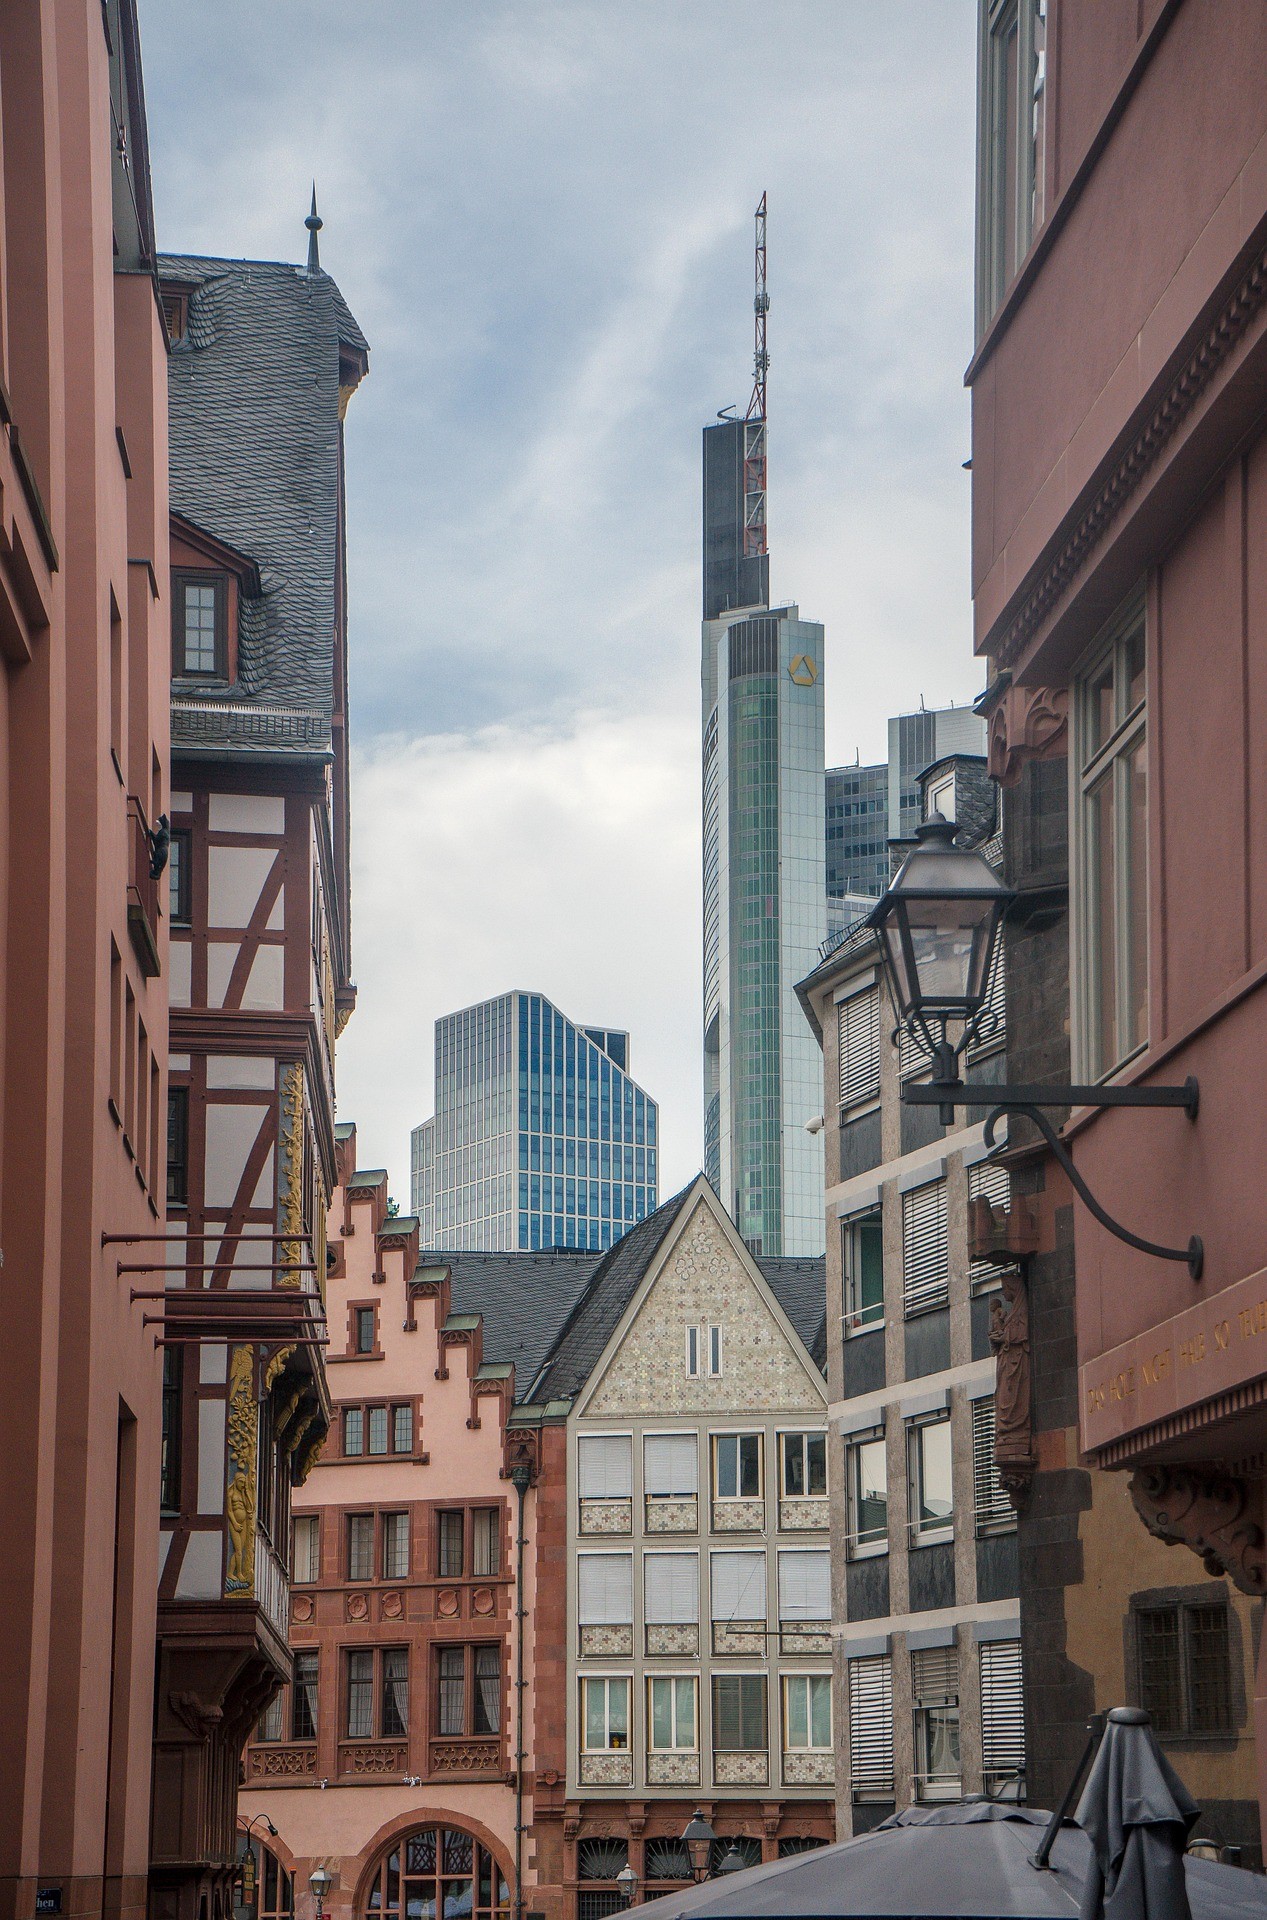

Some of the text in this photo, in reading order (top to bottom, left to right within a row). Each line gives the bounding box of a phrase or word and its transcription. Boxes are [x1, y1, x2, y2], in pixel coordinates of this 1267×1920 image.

[1088, 1383, 1105, 1415] DAS
[1109, 1366, 1135, 1401] HOLZ
[1214, 1319, 1232, 1354] SO
[36, 1897, 54, 1907] hen
